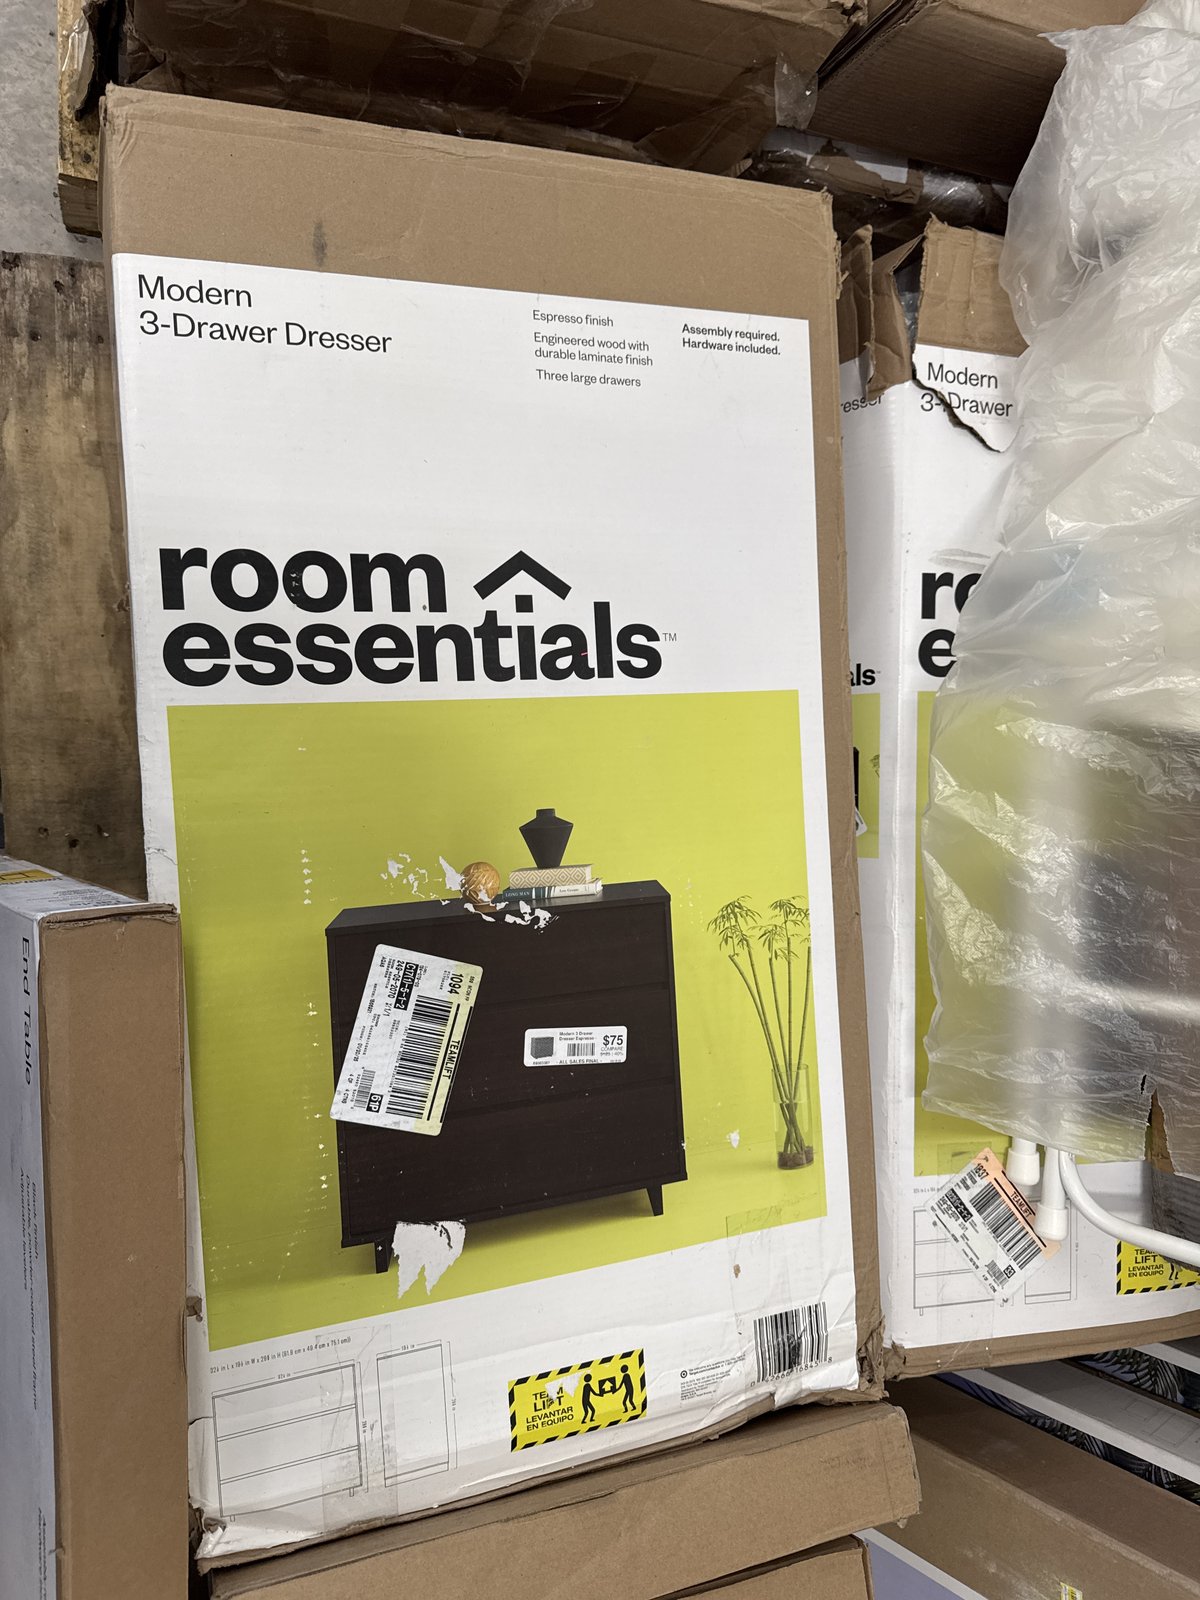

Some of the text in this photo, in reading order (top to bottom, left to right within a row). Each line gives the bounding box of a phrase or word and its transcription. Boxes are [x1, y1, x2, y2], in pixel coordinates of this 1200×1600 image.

[138, 273, 253, 308] Modern
[532, 309, 614, 327] Espresso finish
[139, 310, 392, 353] 3-Drawer Dresser
[681, 323, 780, 342] Assembly required.
[533, 332, 650, 352] Engineered wood with
[682, 338, 781, 356] Hardware included.
[534, 347, 653, 367] durable laminate finish
[536, 368, 642, 387] Three large drawers
[927, 362, 998, 389] Modern
[159, 546, 448, 613] room
[162, 595, 663, 687] essentials
[387, 959, 405, 999] 249-05-2070
[448, 973, 464, 995] 1094
[22, 936, 32, 1086] End Table
[602, 1034, 624, 1046] $75
[442, 1039, 461, 1080] TEAMLIFT
[368, 1094, 381, 1112] 61P
[973, 1163, 990, 1180] 1837
[1010, 1190, 1033, 1219] TEAMLIFT
[1128, 1264, 1164, 1272] LEVANTAR
[1135, 1255, 1158, 1264] LIFT
[1005, 1266, 1014, 1277] 33
[526, 1406, 574, 1424] LEVANTAR
[526, 1413, 574, 1432] EN EQUIPO
